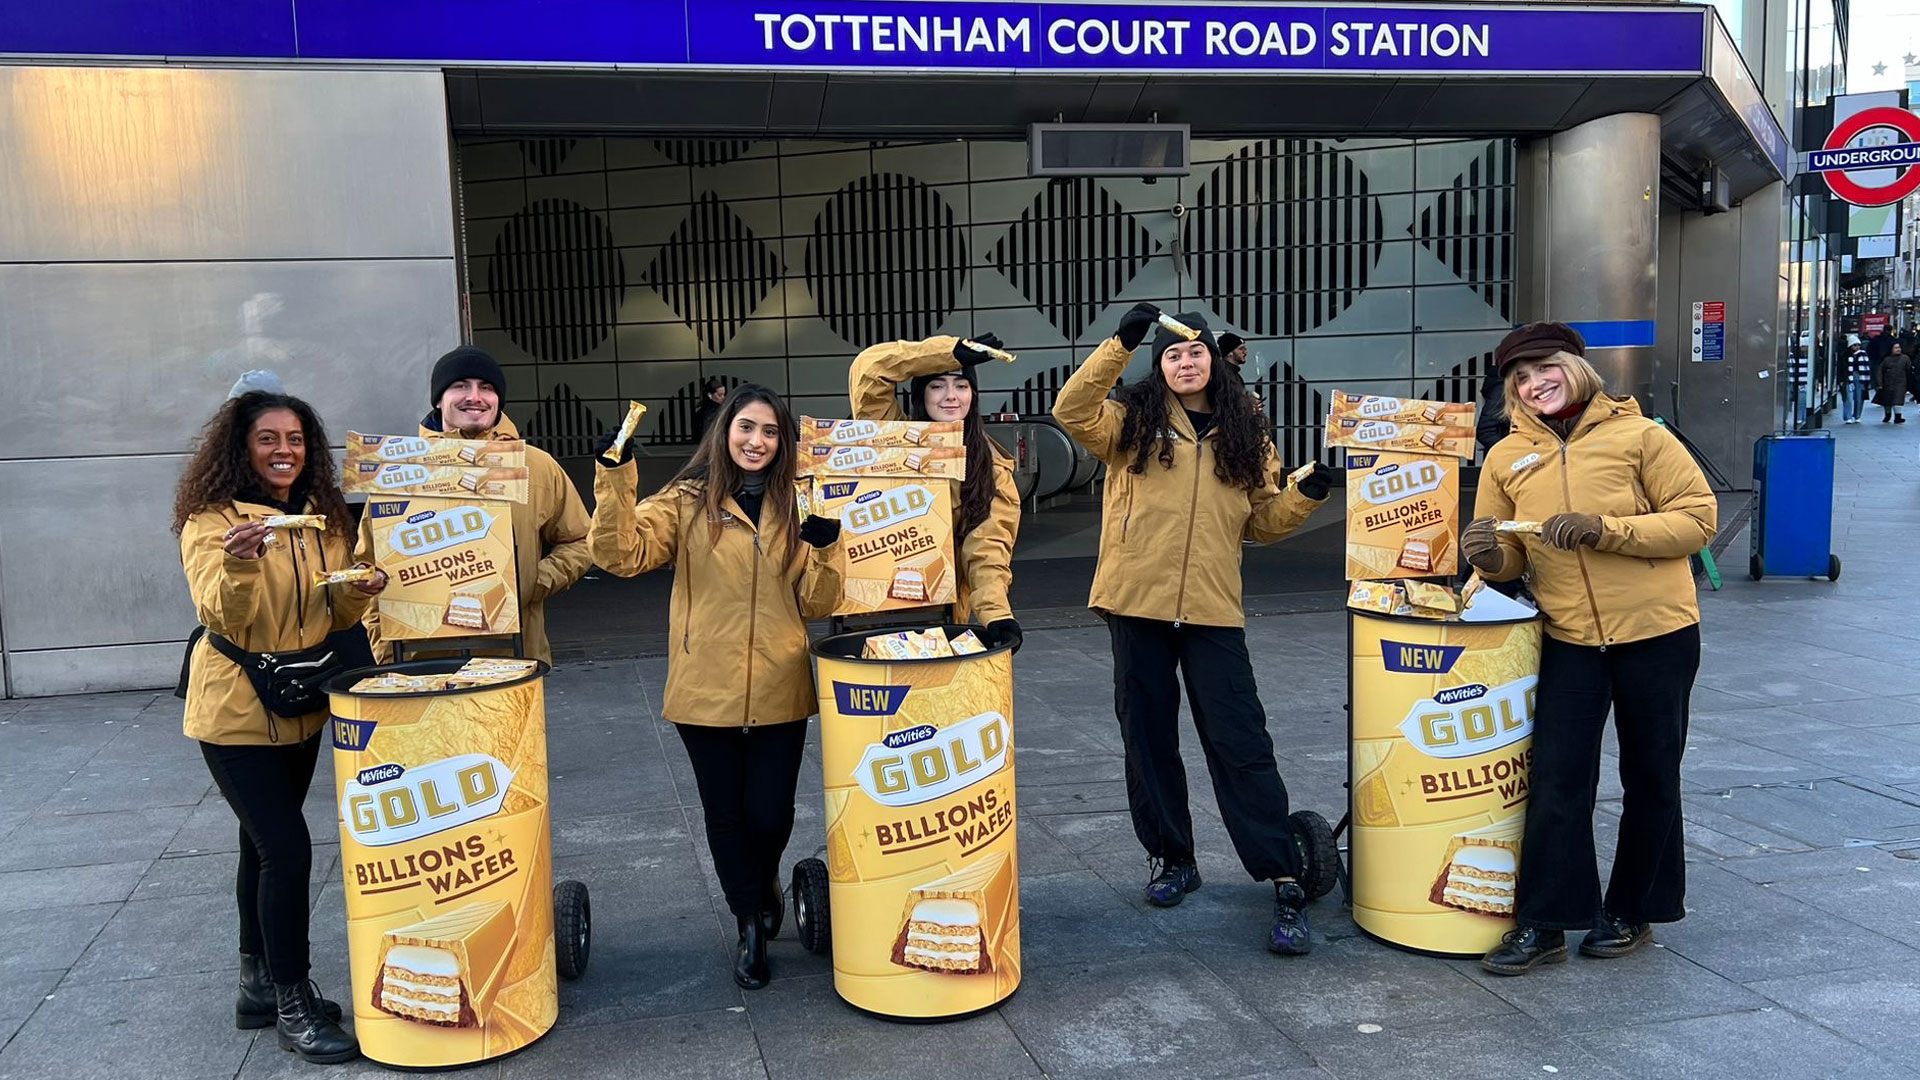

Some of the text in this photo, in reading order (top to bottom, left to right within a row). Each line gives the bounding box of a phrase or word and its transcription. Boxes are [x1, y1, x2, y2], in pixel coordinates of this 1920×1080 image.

[754, 13, 1490, 58] TOTTENHAM COURT ROAD STATION
[1363, 400, 1397, 414] GOLD
[817, 420, 831, 428] NEW
[836, 423, 875, 440] GOLD
[1359, 425, 1395, 440] GOLD
[385, 440, 425, 457] GOLD
[813, 447, 827, 455] NEW
[833, 450, 873, 467] GOLD
[1353, 457, 1372, 467] NEW
[381, 468, 425, 485] GOLD
[1368, 464, 1438, 499] GOLD
[829, 484, 850, 496] NEW
[378, 503, 401, 515] NEW
[849, 488, 926, 529] GOLD
[1365, 500, 1428, 528] BILLIONS
[1402, 509, 1443, 528] WAFER
[400, 511, 485, 550] GOLD
[847, 526, 919, 559] BILLIONS
[889, 534, 935, 558] WAFER
[398, 550, 476, 582] BILLIONS
[445, 559, 495, 582] WAFER
[1400, 646, 1444, 670] NEW
[850, 687, 890, 712] NEW
[334, 720, 360, 747] NEW
[870, 718, 1005, 796] GOLD
[349, 760, 499, 834] GOLD
[876, 788, 997, 847] BILLIONS
[954, 800, 1012, 849] WAFER
[355, 834, 485, 886] BILLIONS
[425, 847, 515, 895] WAFER
